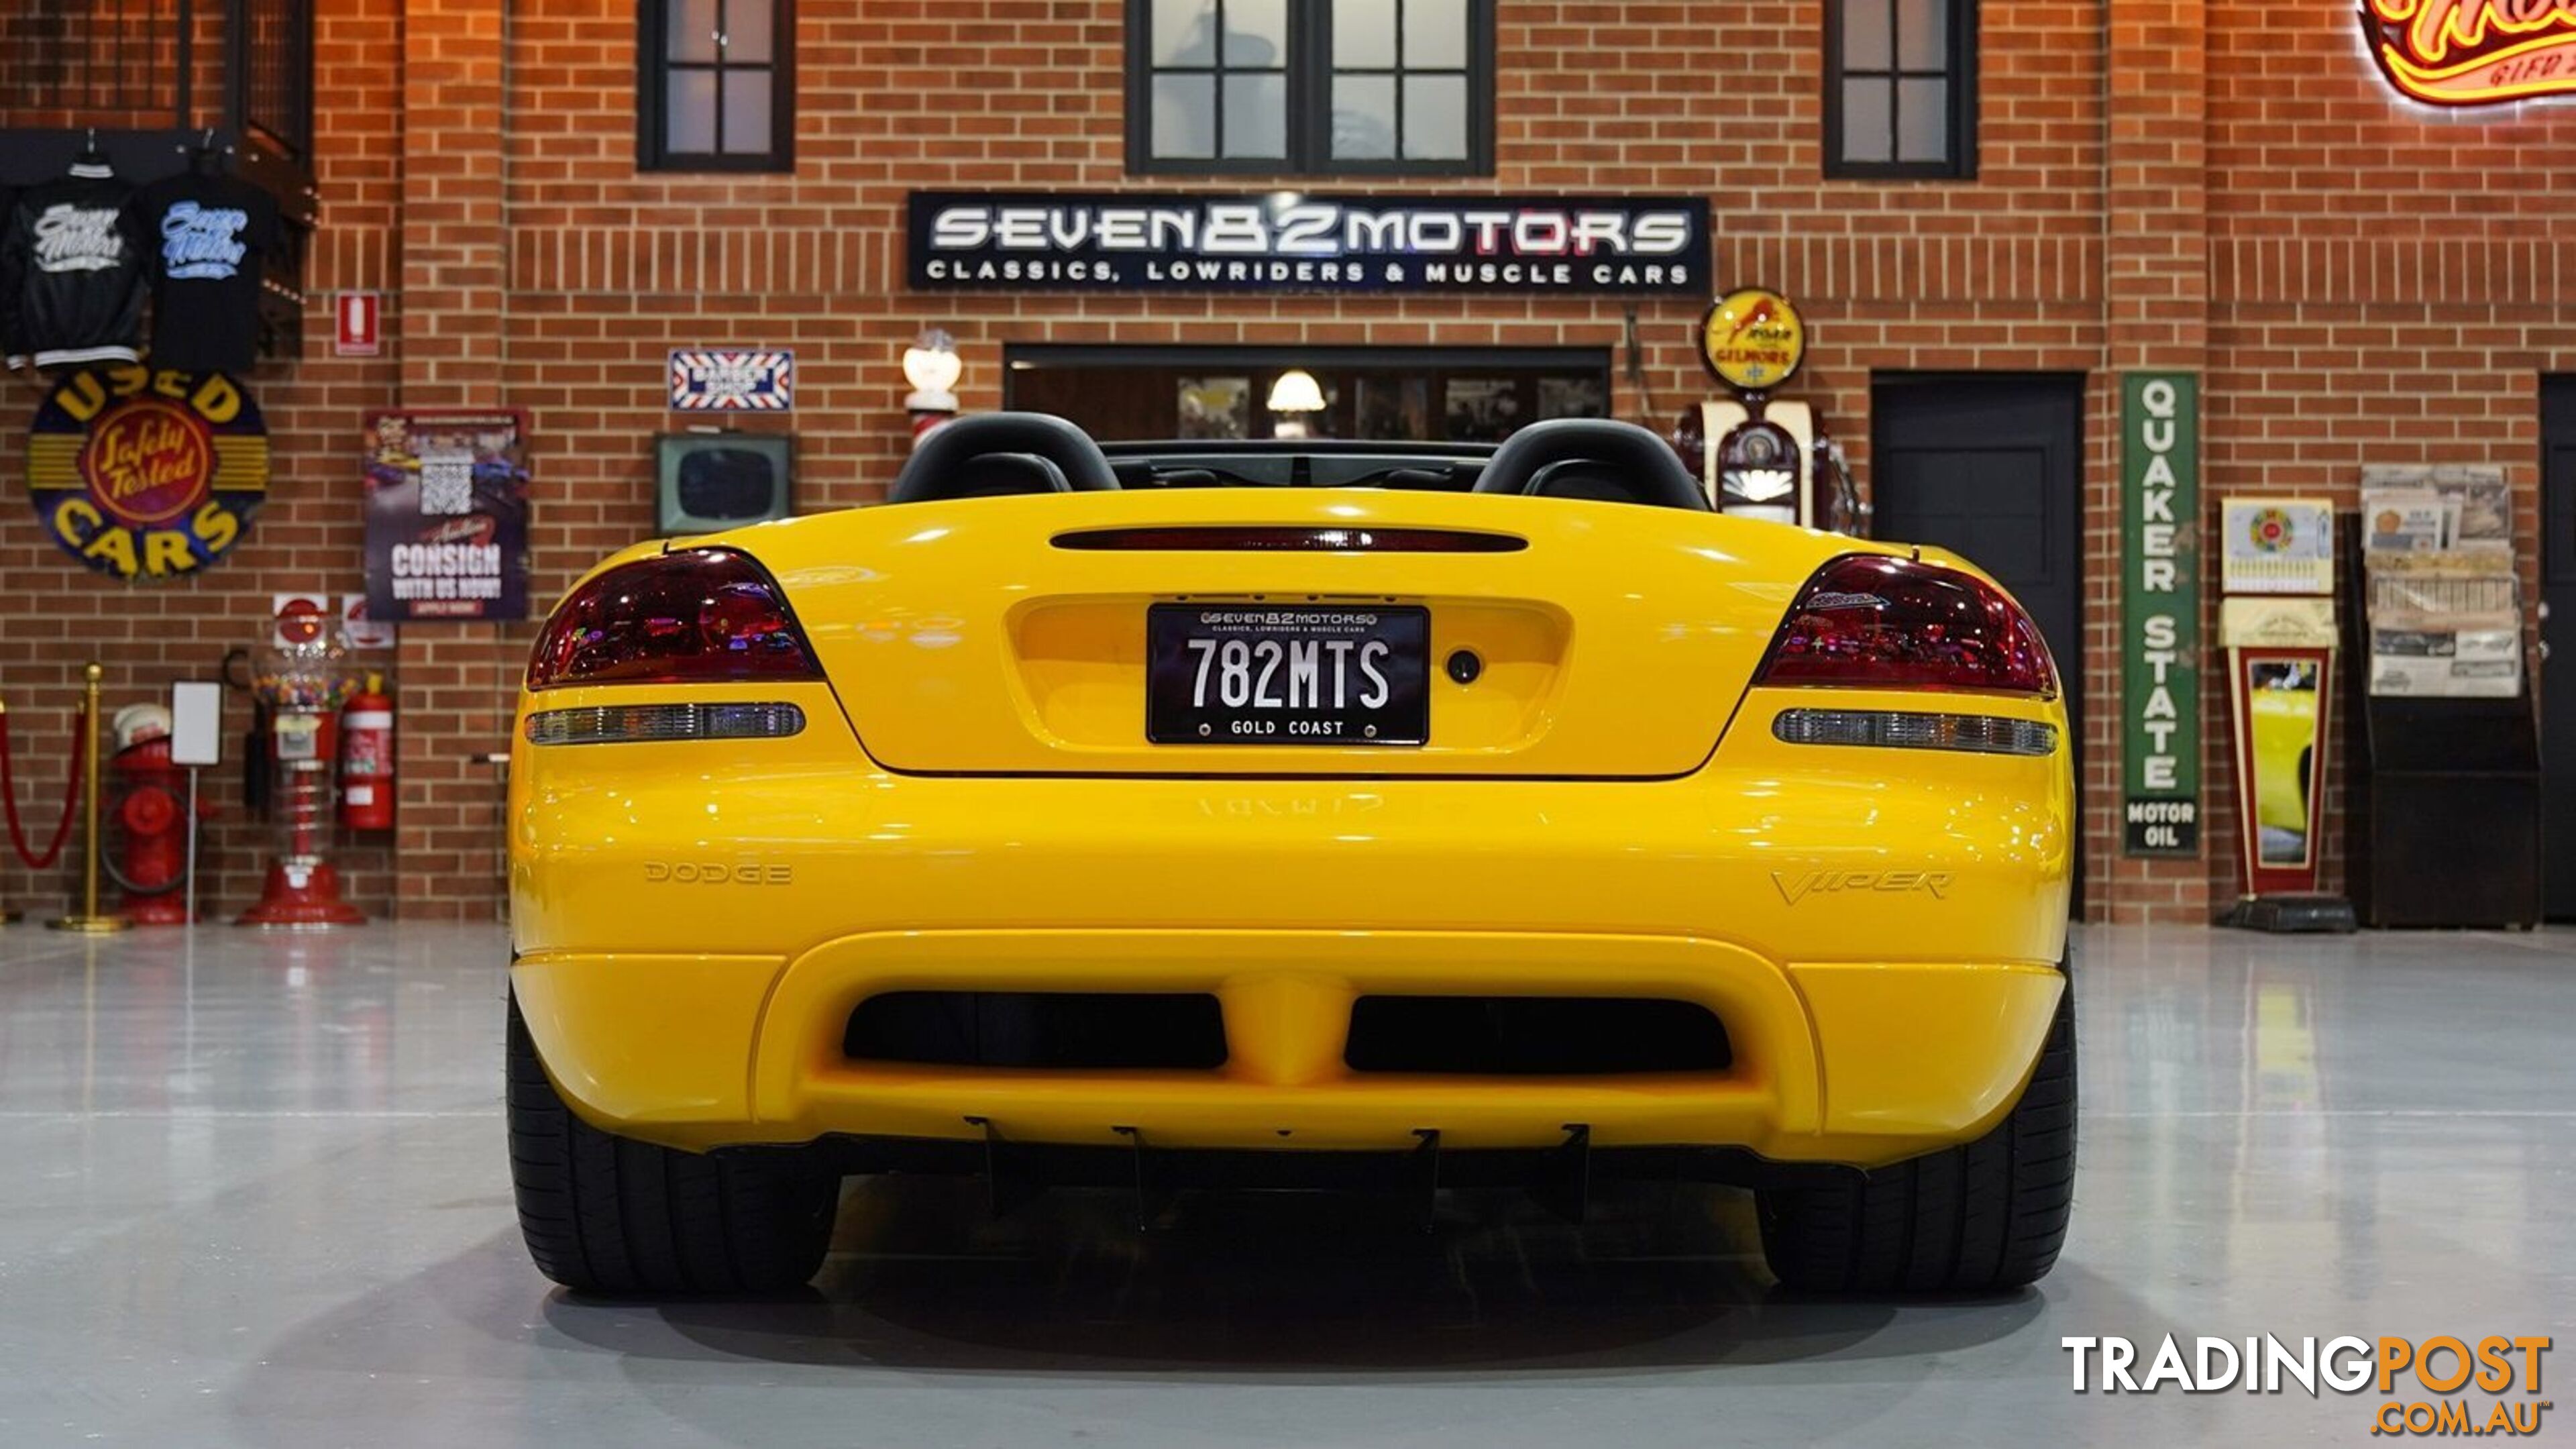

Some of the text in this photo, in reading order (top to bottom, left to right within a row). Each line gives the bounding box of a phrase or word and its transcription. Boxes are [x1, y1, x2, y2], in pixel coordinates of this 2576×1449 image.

[926, 260, 1688, 284] CLASSICS, LOWRIDERS & MUSCLE CARS
[55, 366, 241, 423] USED
[99, 417, 186, 472] Safety
[109, 448, 195, 500] Tested
[55, 498, 238, 577] CARS
[392, 543, 501, 576] CONSIGN
[392, 578, 434, 600] WITH
[435, 578, 457, 598] US
[2142, 380, 2177, 789] QUAKER STATE
[1187, 639, 1389, 709] 782MTS
[1232, 720, 1344, 735] GOLD COAST
[2128, 802, 2194, 824] MOTOR
[2145, 826, 2180, 847] OIL
[644, 861, 792, 885] DODGE
[1771, 870, 1955, 906] VIPER
